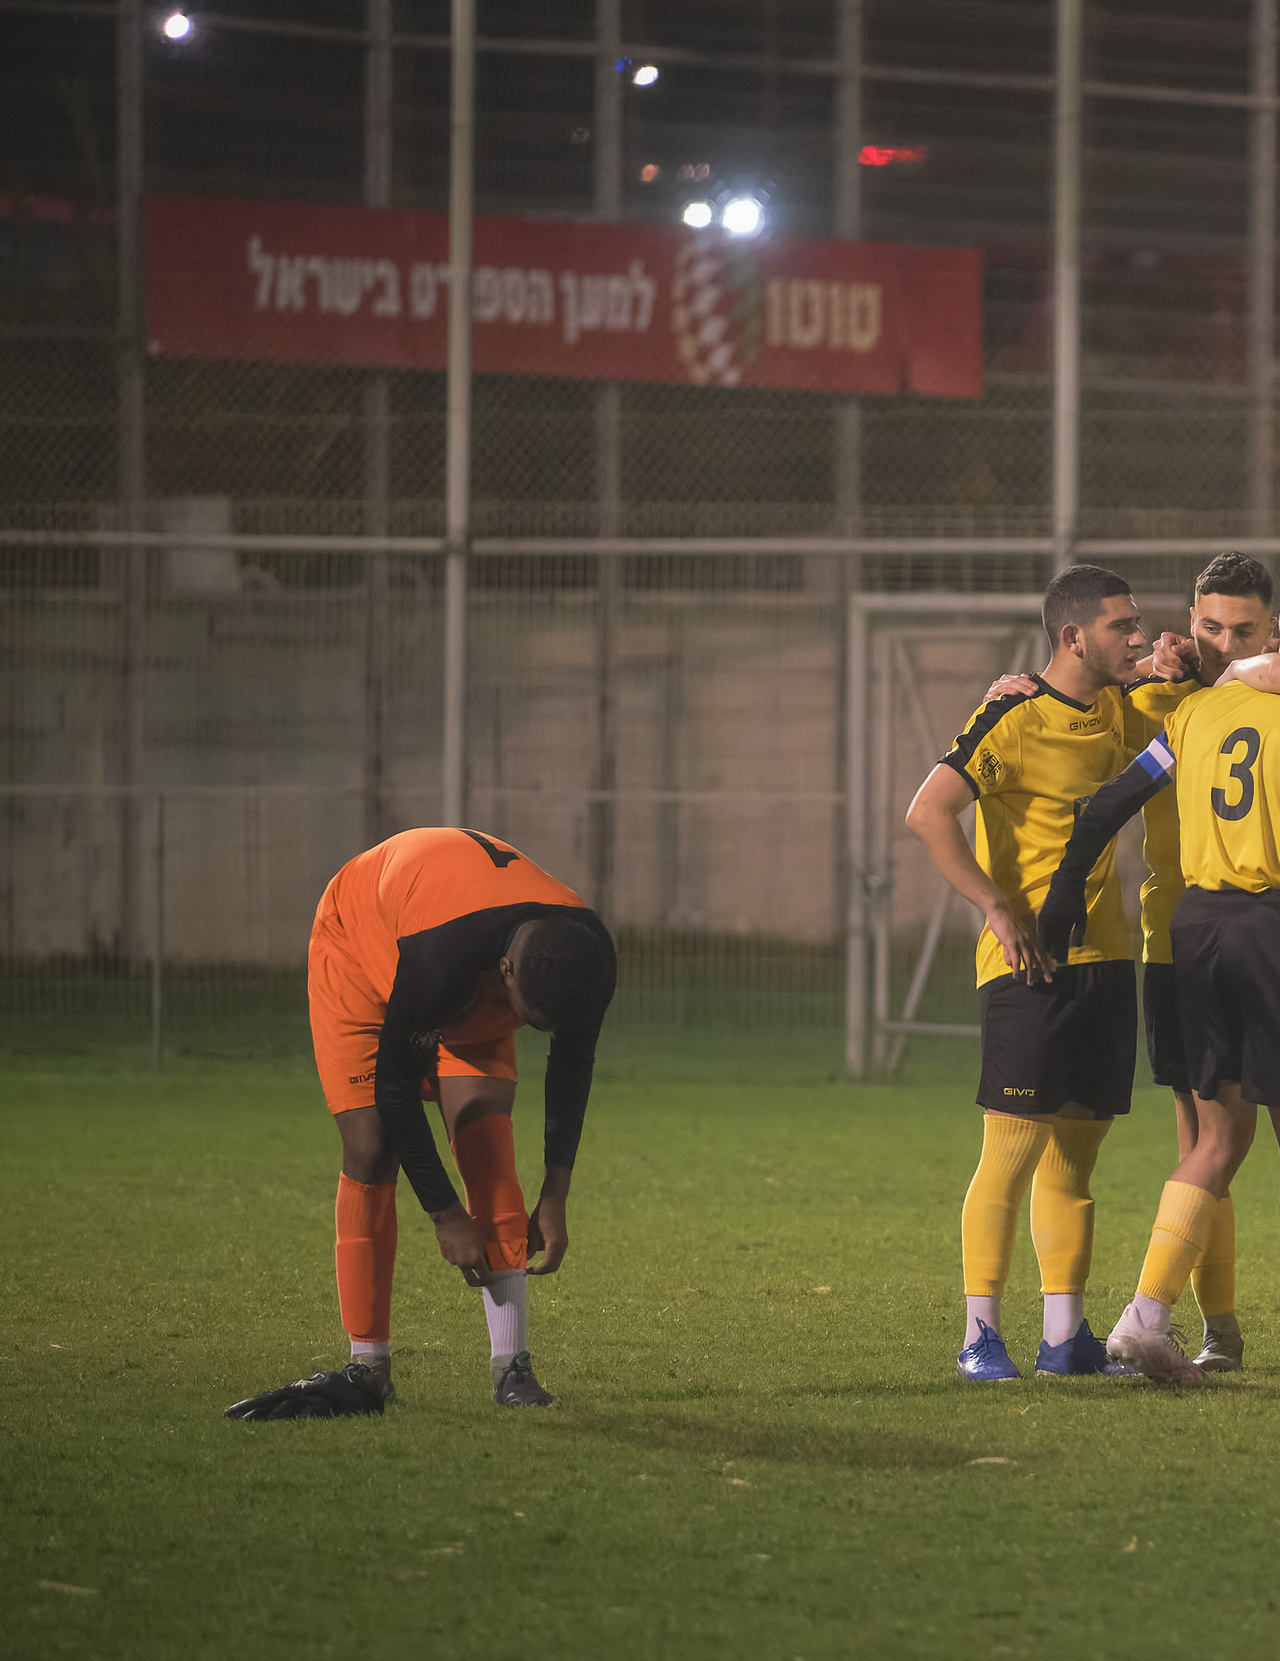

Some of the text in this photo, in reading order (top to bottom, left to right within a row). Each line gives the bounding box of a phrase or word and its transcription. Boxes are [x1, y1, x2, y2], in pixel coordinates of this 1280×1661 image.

[249, 235, 882, 353] טוטו למען הספרט בישראל
[1211, 727, 1261, 821] 3
